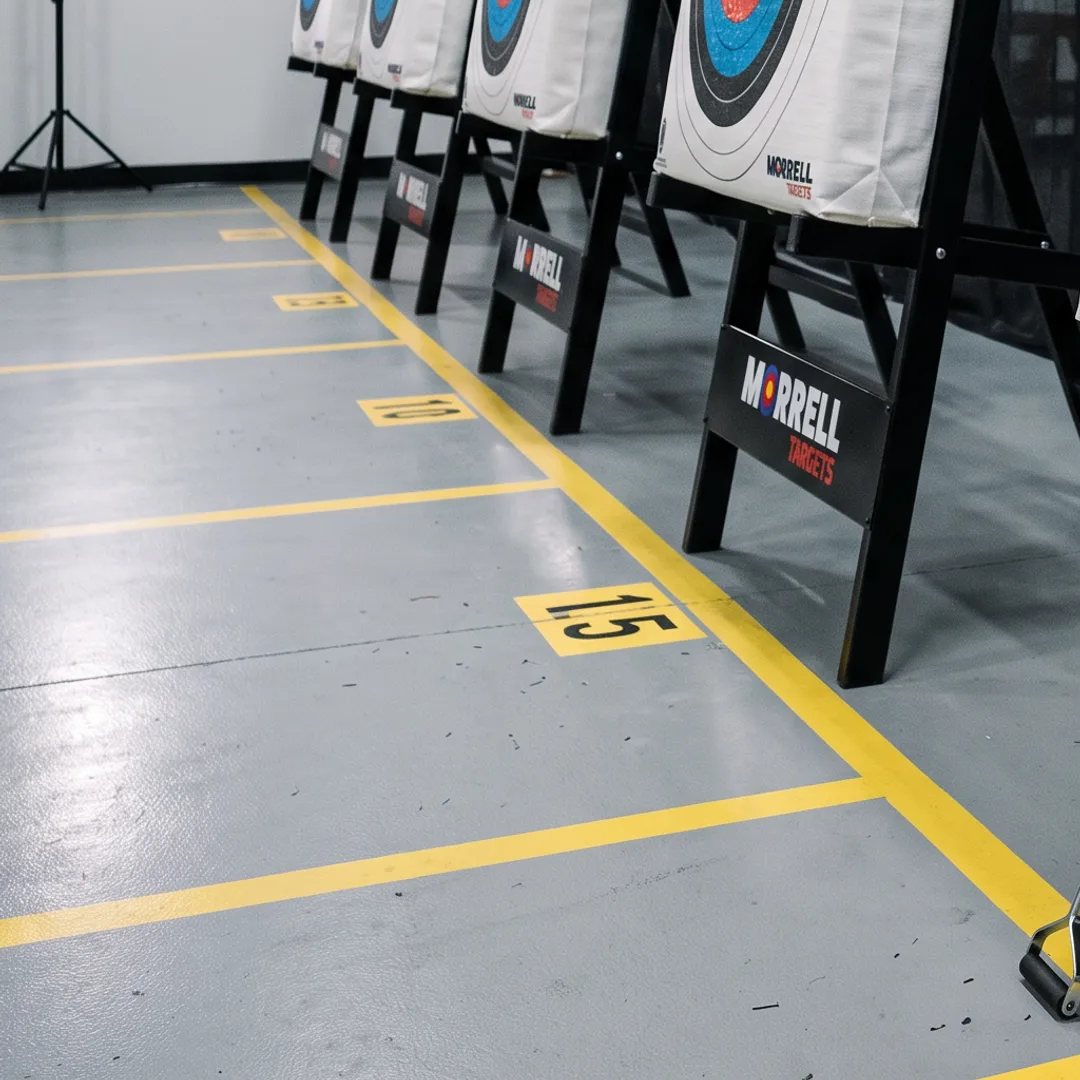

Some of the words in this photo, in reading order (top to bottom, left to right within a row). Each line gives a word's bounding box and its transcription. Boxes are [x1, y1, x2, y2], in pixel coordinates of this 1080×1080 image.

[767, 154, 813, 184] MORRELL
[372, 399, 461, 419] 10
[740, 354, 841, 454] MORRELL
[788, 434, 836, 486] TARGETS
